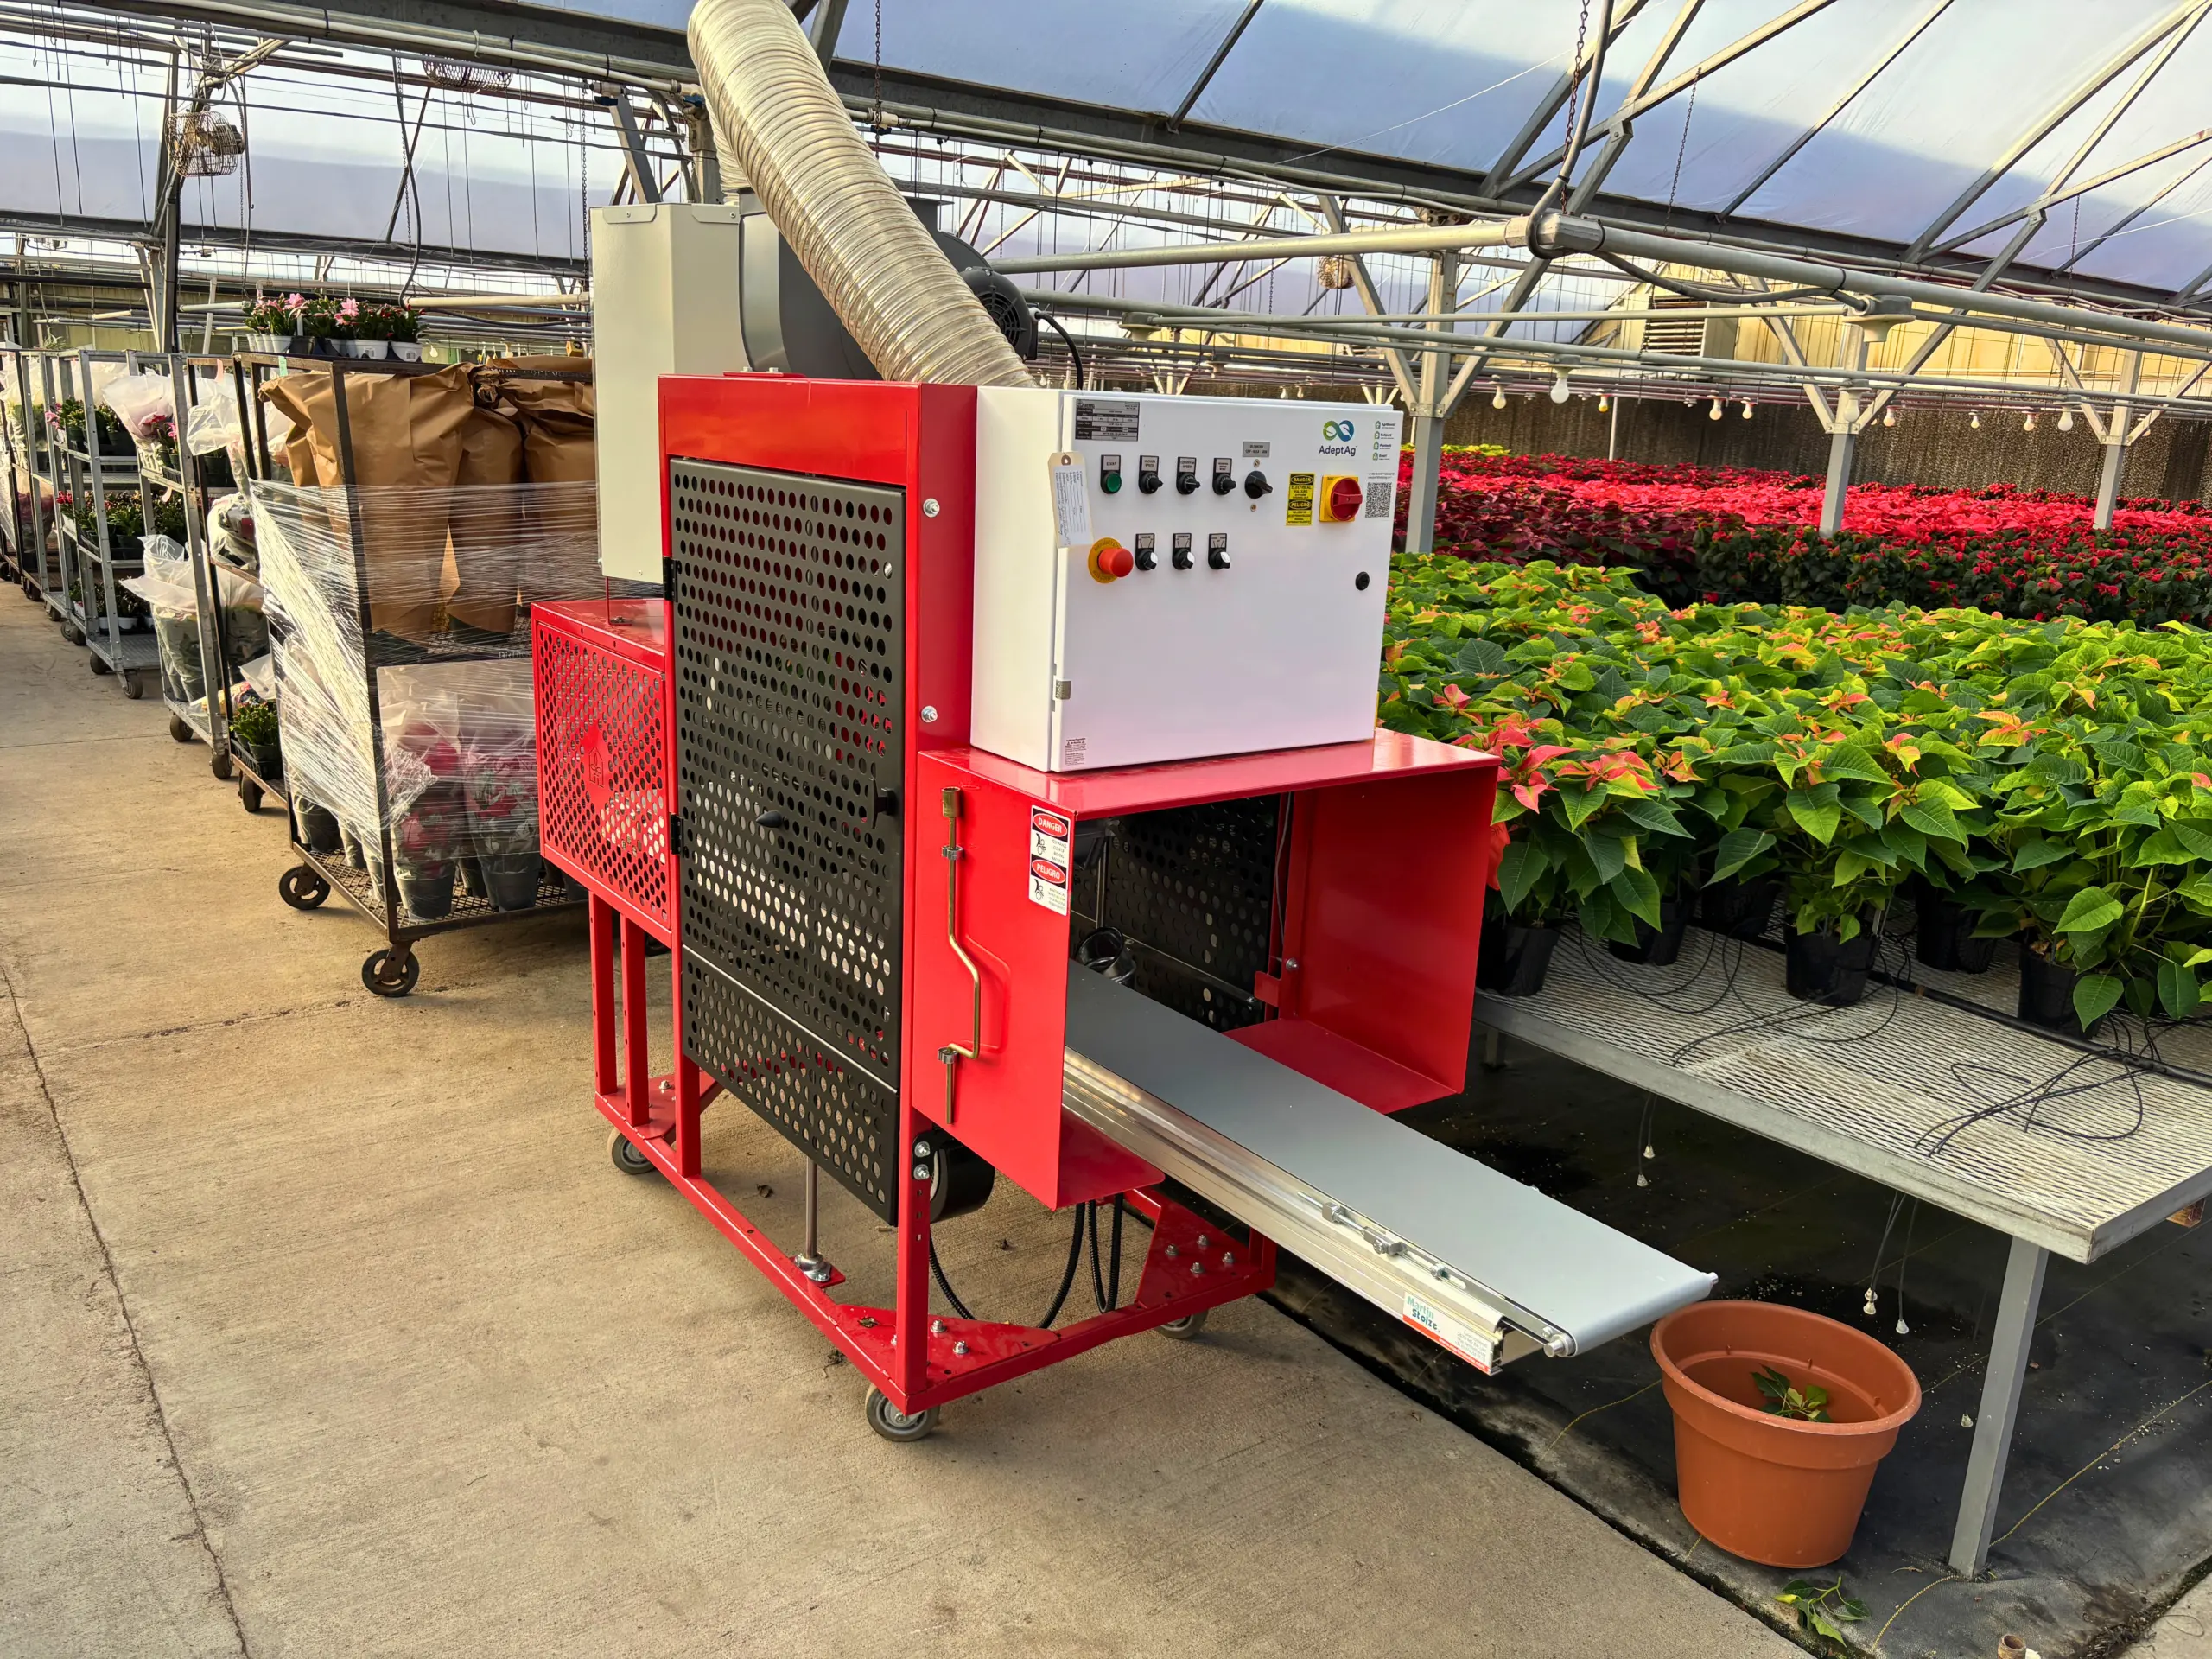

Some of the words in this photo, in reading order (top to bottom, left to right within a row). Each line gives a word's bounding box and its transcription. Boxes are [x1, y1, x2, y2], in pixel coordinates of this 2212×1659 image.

[1319, 445, 1356, 456] AdeptAg
[1038, 817, 1062, 833] DANGER
[1037, 863, 1060, 880] PELIGRO
[1407, 1296, 1434, 1319] Martin
[1412, 1308, 1438, 1330] Stolze
